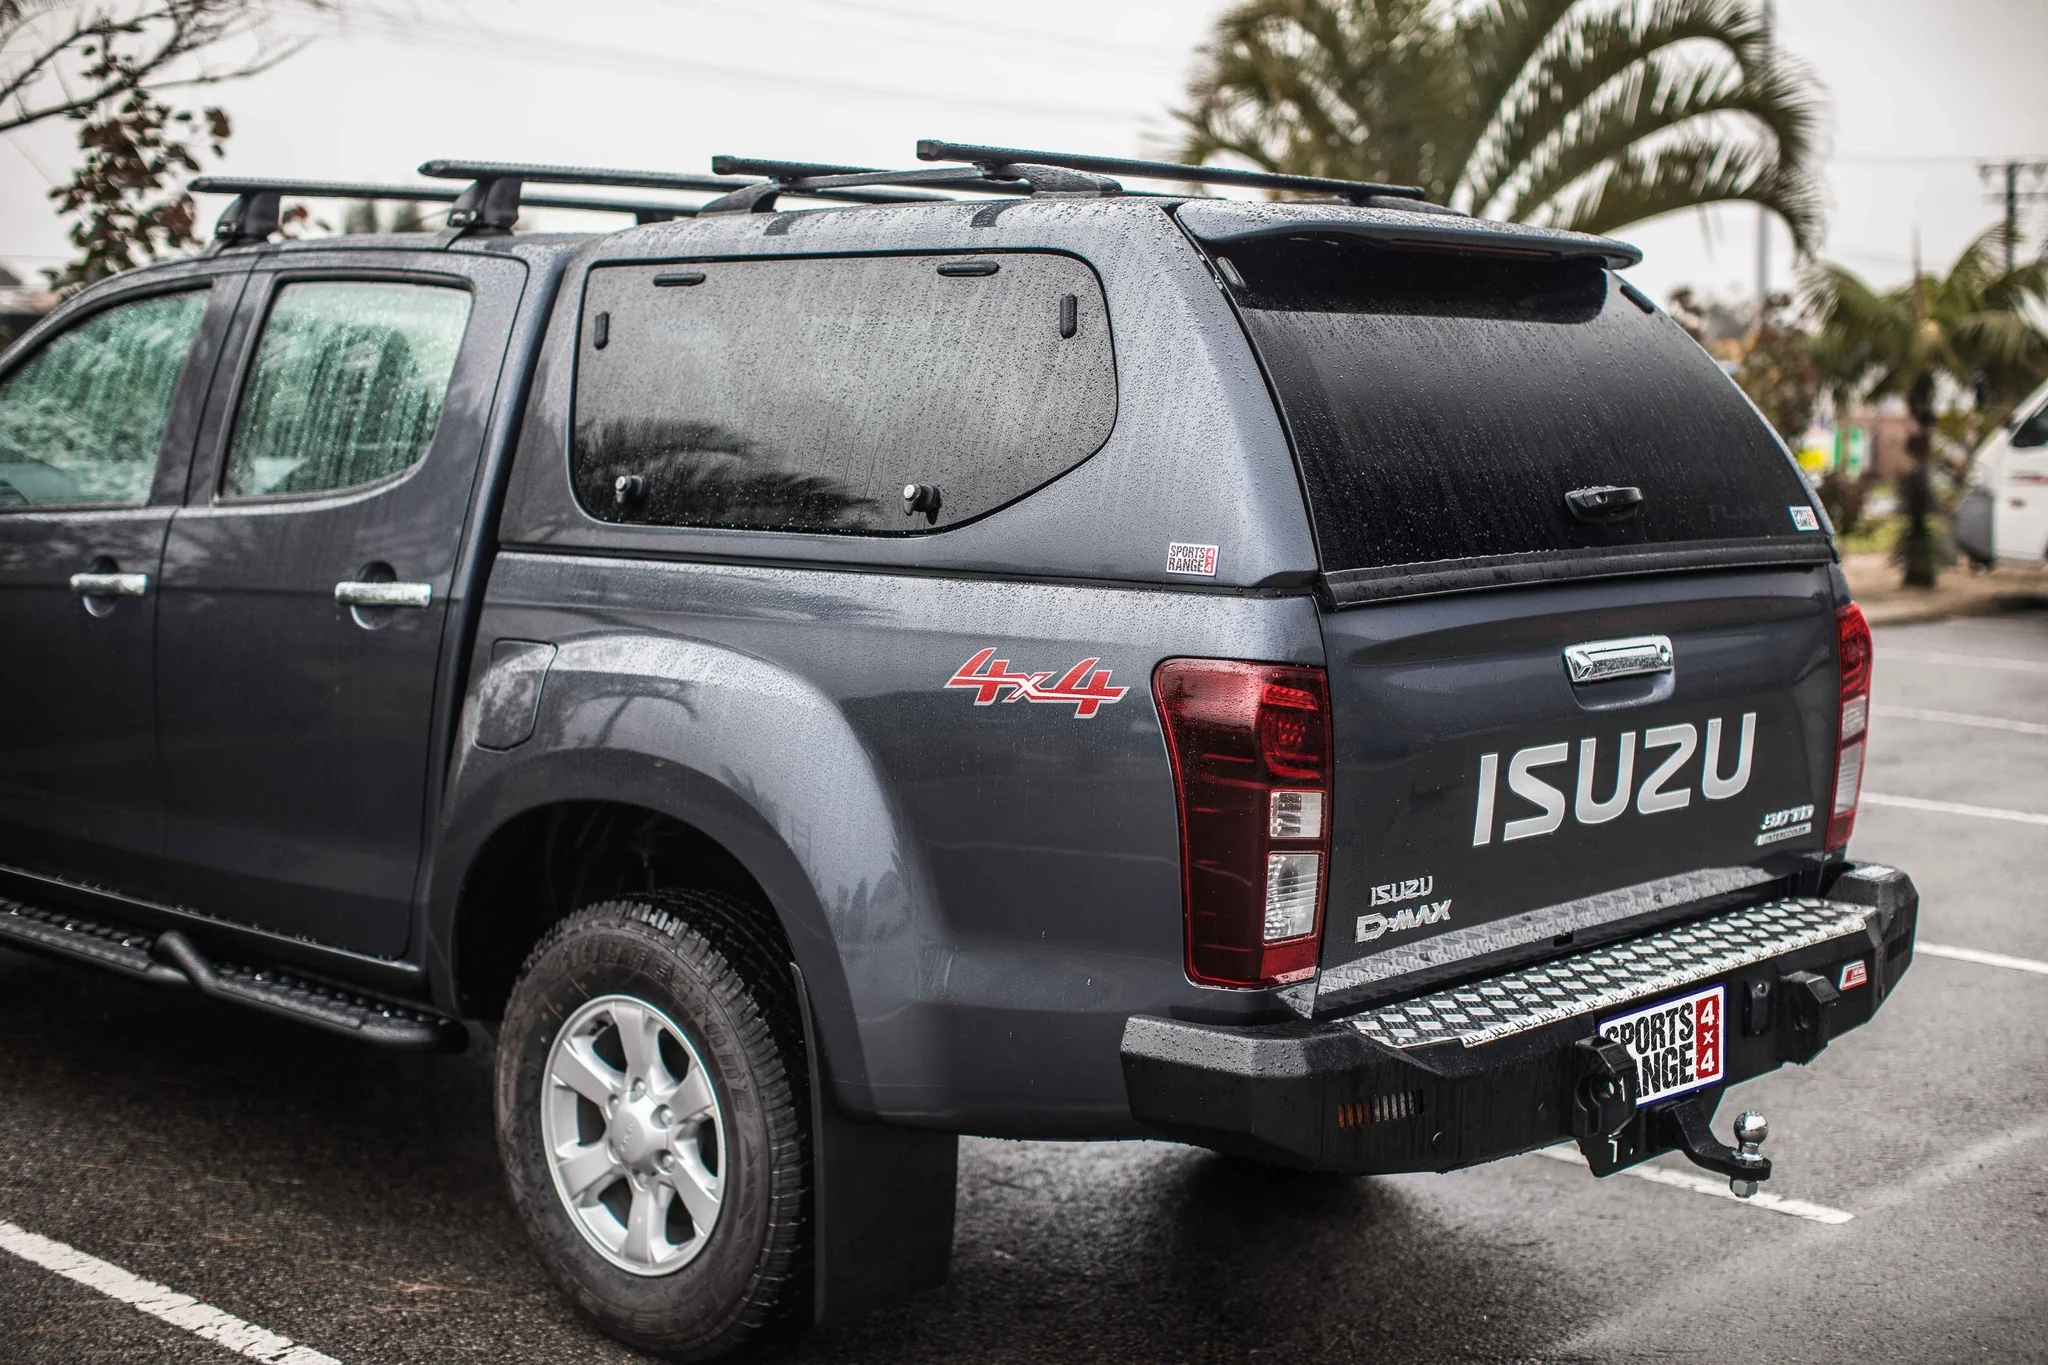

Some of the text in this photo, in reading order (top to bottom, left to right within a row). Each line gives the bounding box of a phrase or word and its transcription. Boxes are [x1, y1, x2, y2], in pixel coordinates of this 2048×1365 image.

[1168, 557, 1204, 573] RANGE
[1170, 545, 1205, 559] SPORTS
[943, 647, 1131, 719] 4x4
[1473, 712, 1757, 847] ISUZU
[1765, 826, 1807, 842] INTERCOOLER
[1370, 875, 1433, 907] ISUZU
[1355, 899, 1452, 943] D-MAX
